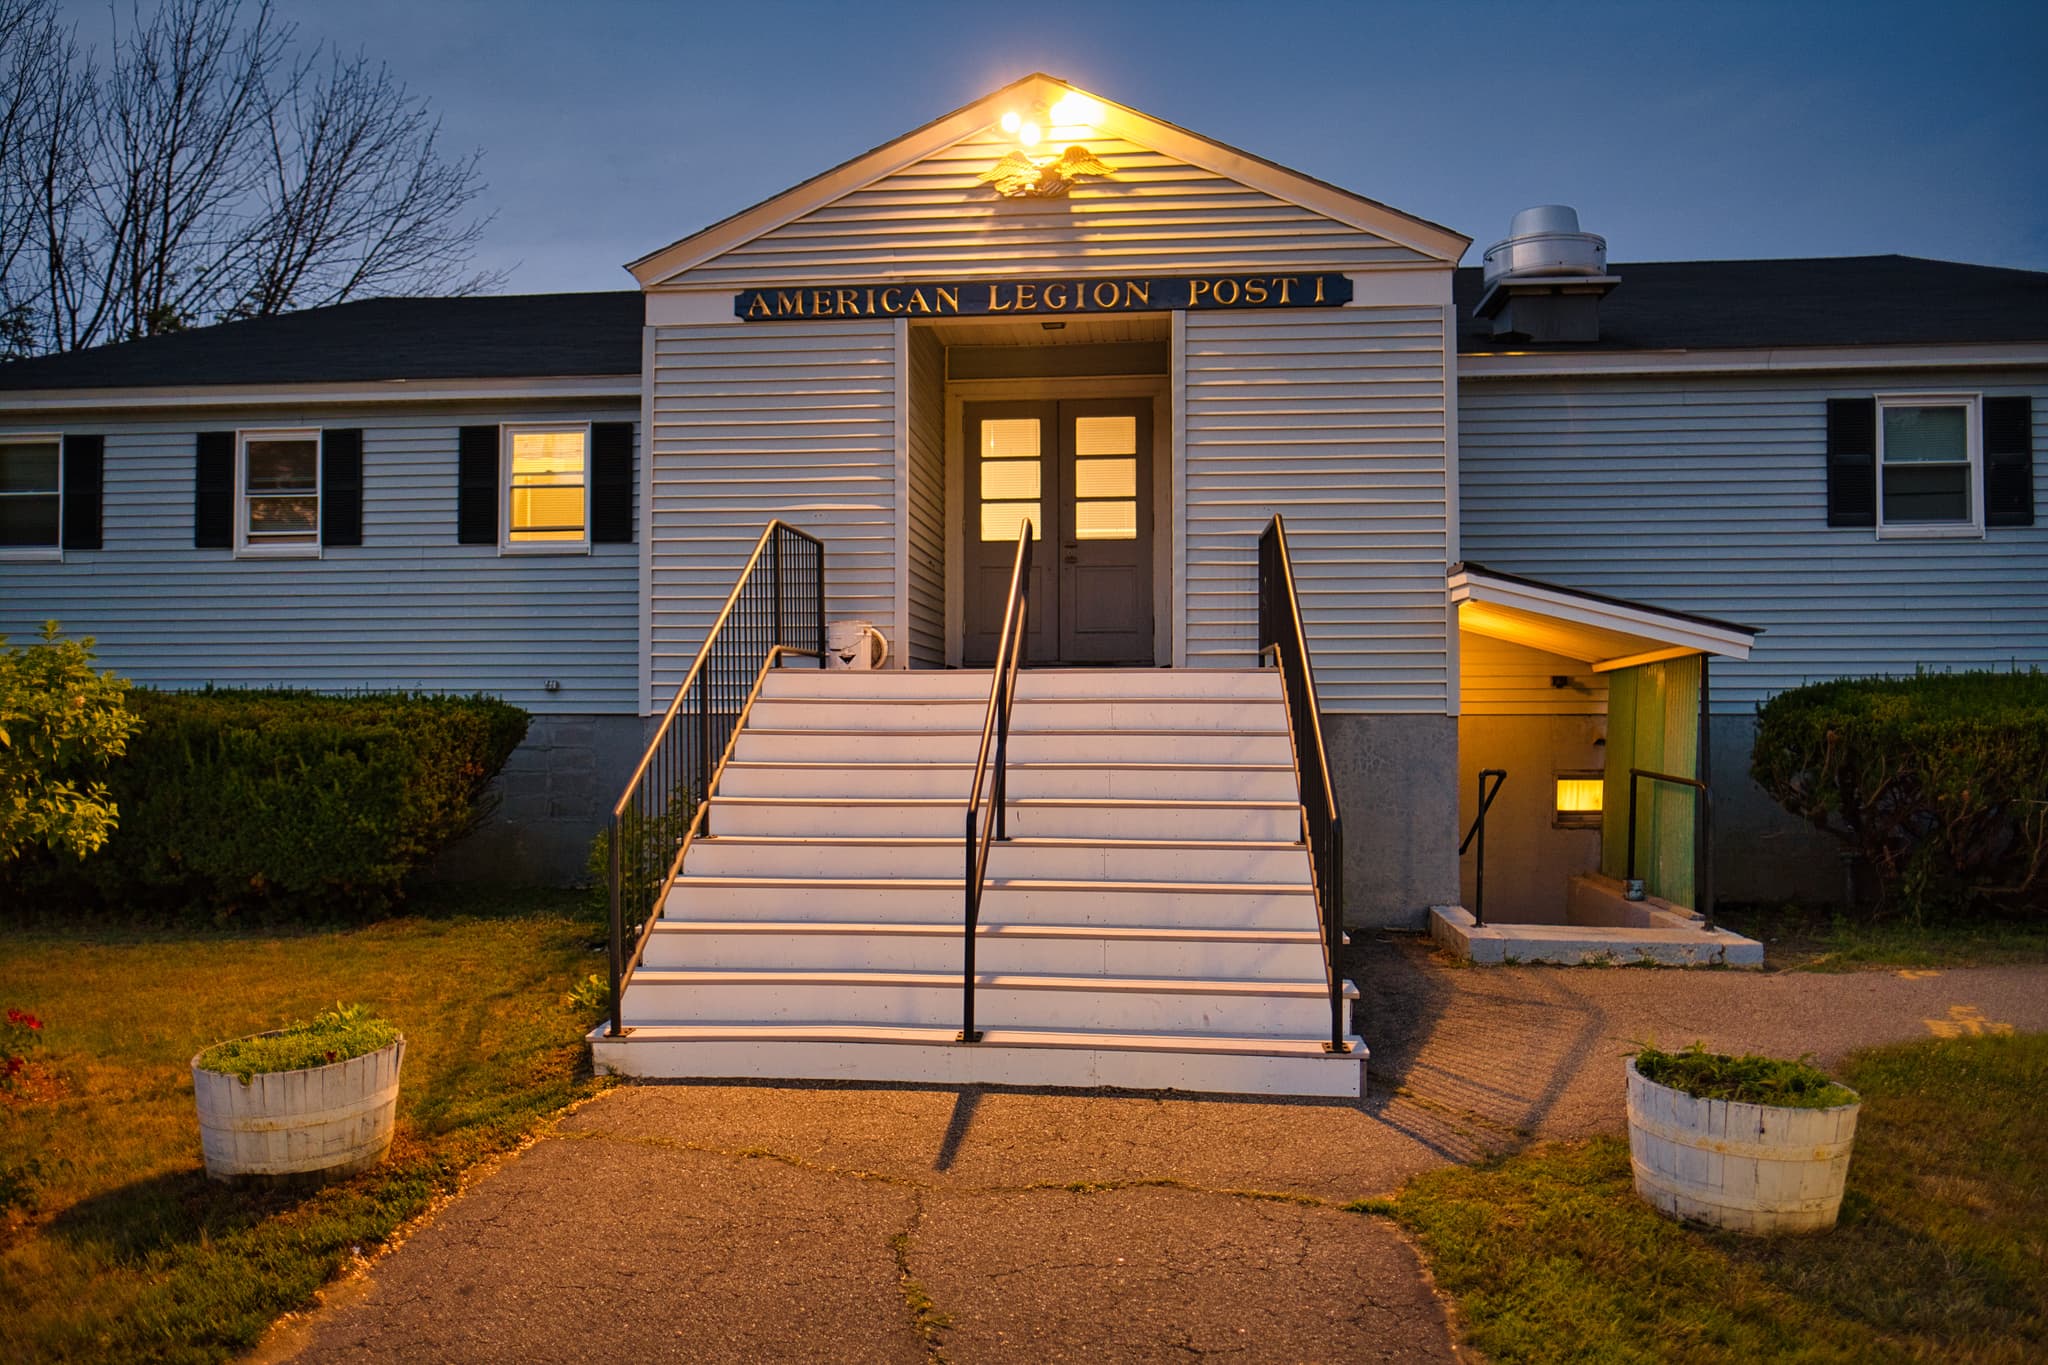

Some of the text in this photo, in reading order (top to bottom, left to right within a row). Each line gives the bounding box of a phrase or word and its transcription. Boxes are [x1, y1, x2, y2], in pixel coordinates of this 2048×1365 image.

[748, 287, 959, 316] AMERICAN
[988, 281, 1149, 311] LEGION
[1189, 278, 1298, 306] POST
